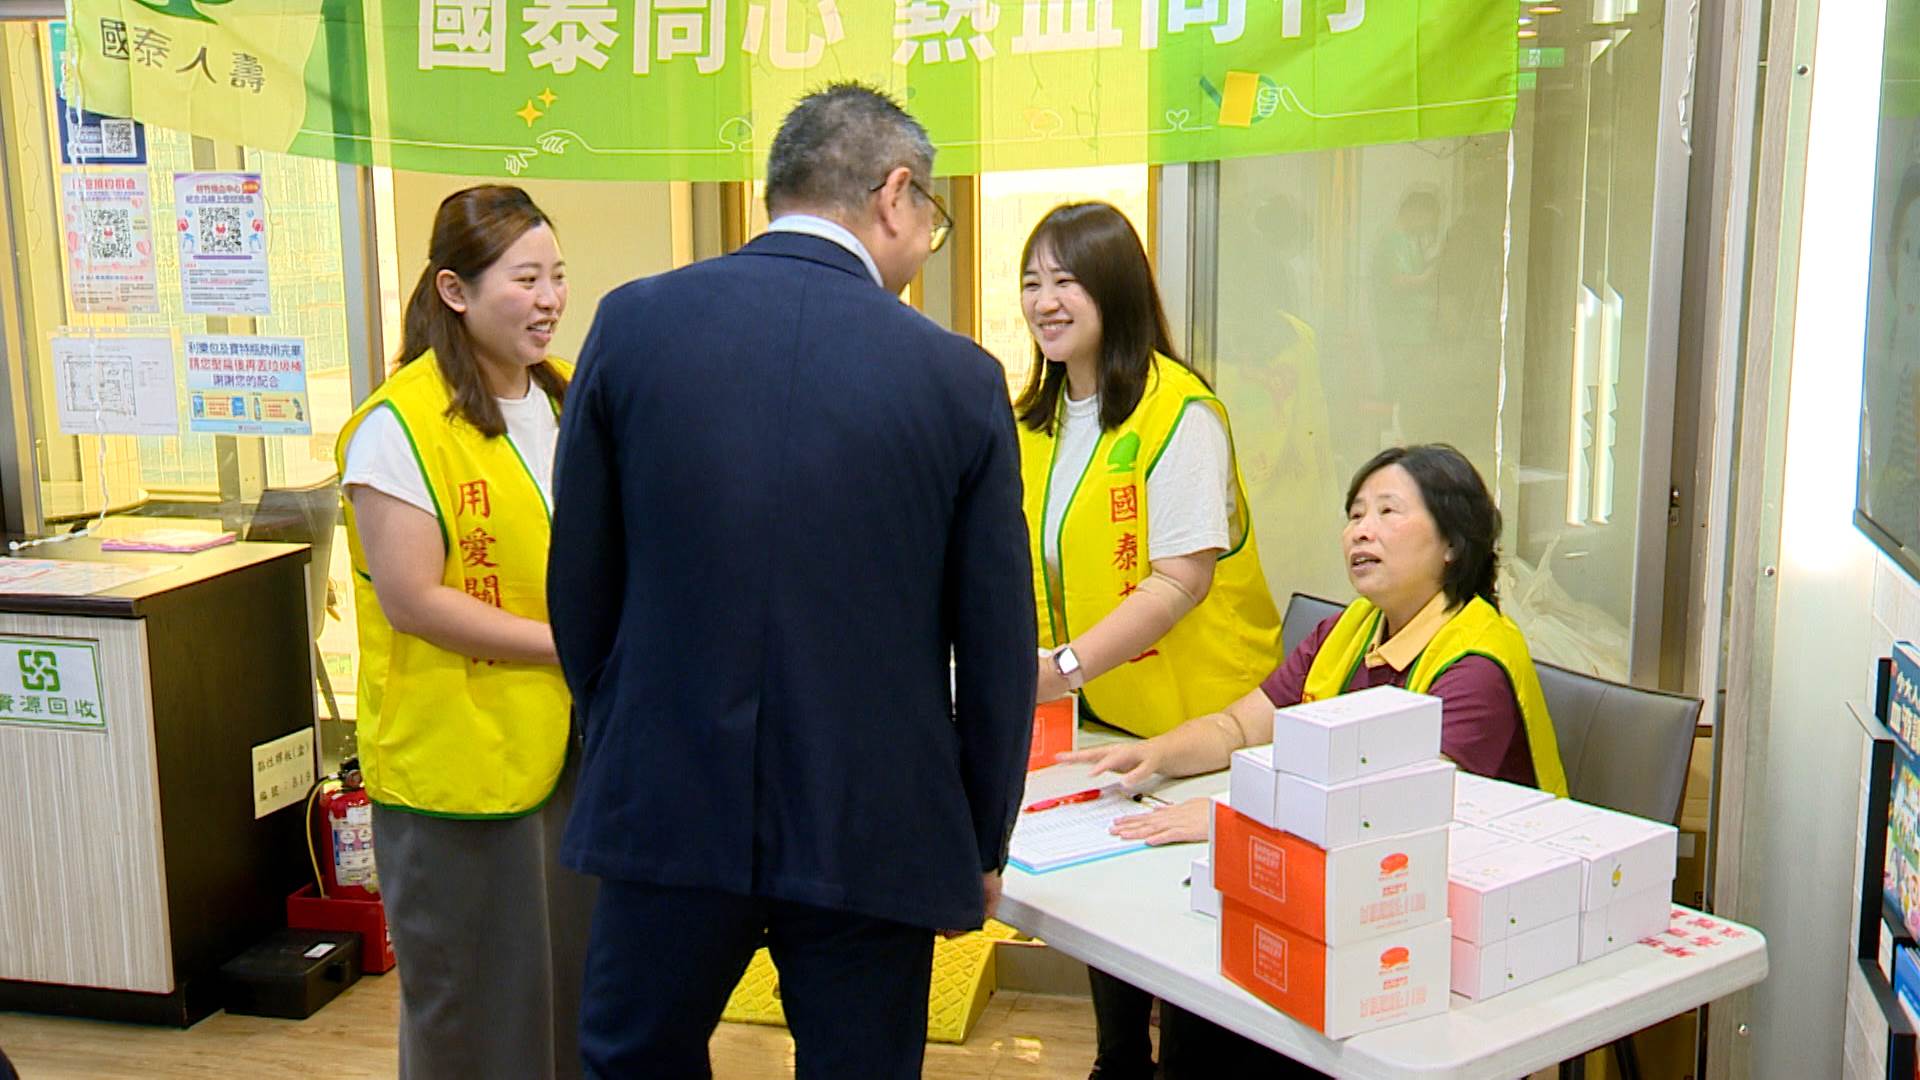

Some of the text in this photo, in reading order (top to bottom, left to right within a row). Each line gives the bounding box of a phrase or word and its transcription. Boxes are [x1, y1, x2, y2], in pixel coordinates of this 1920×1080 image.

[100, 17, 265, 94] 國泰人壽
[188, 341, 301, 356] 利樂包及寶特瓶飲用完畢
[212, 374, 279, 388] 謝謝您的配合
